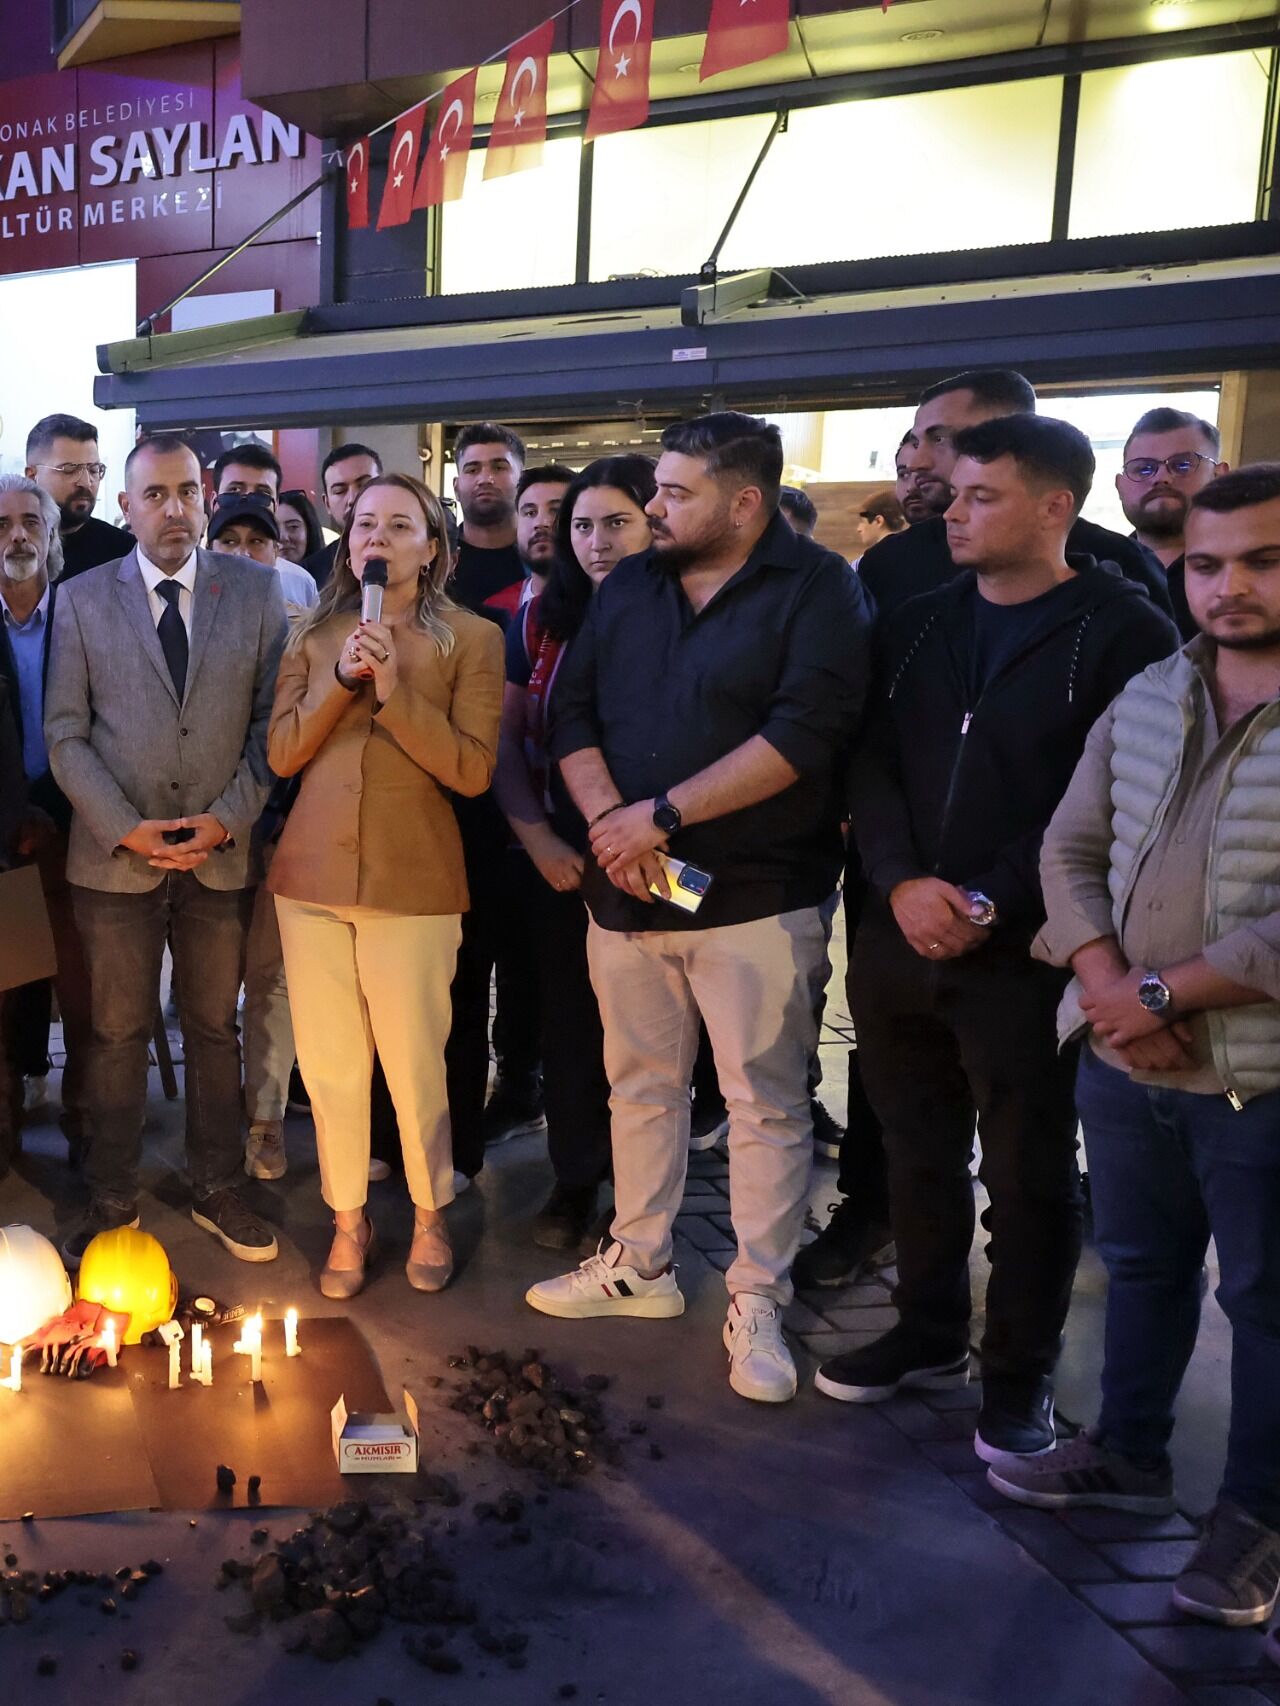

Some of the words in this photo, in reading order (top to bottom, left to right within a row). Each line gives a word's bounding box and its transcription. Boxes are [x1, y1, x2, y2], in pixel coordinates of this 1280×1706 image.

[65, 89, 194, 131] BELEDİYESİ
[89, 110, 301, 187] SAYLAN
[83, 181, 223, 228] MERKEZİ
[354, 1445, 402, 1456] AKMISIR
